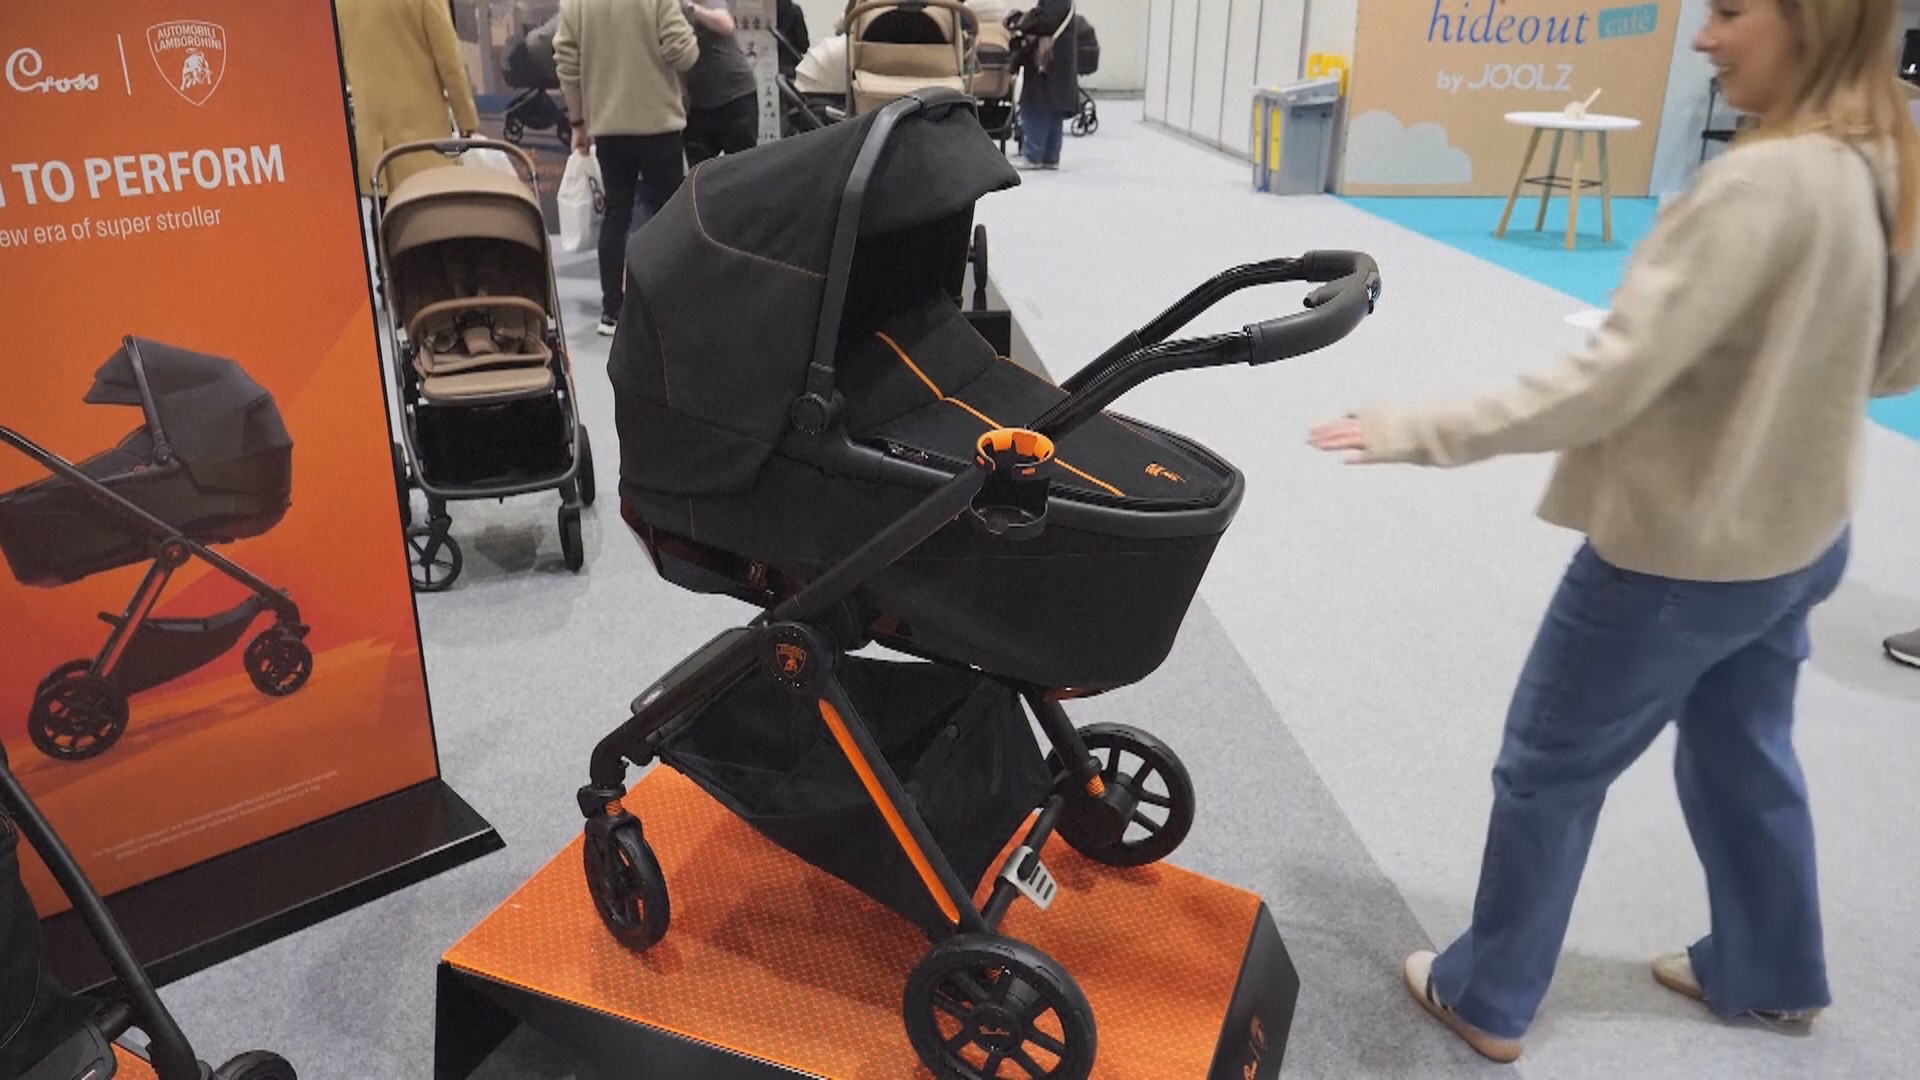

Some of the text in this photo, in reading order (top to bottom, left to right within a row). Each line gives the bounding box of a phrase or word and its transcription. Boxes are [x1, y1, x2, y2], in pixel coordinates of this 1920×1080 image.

[158, 25, 216, 40] AUTOMOBILI
[1427, 0, 1590, 45] hideout
[154, 36, 222, 52] LAMBORGHINI
[5, 47, 99, 93] Cross
[1437, 63, 1575, 94] by JOOLZ
[11, 160, 76, 205] TO
[84, 144, 285, 199] PERFORM
[33, 222, 66, 244] era
[71, 217, 92, 240] of
[96, 213, 152, 240] super
[156, 206, 221, 231] stroller
